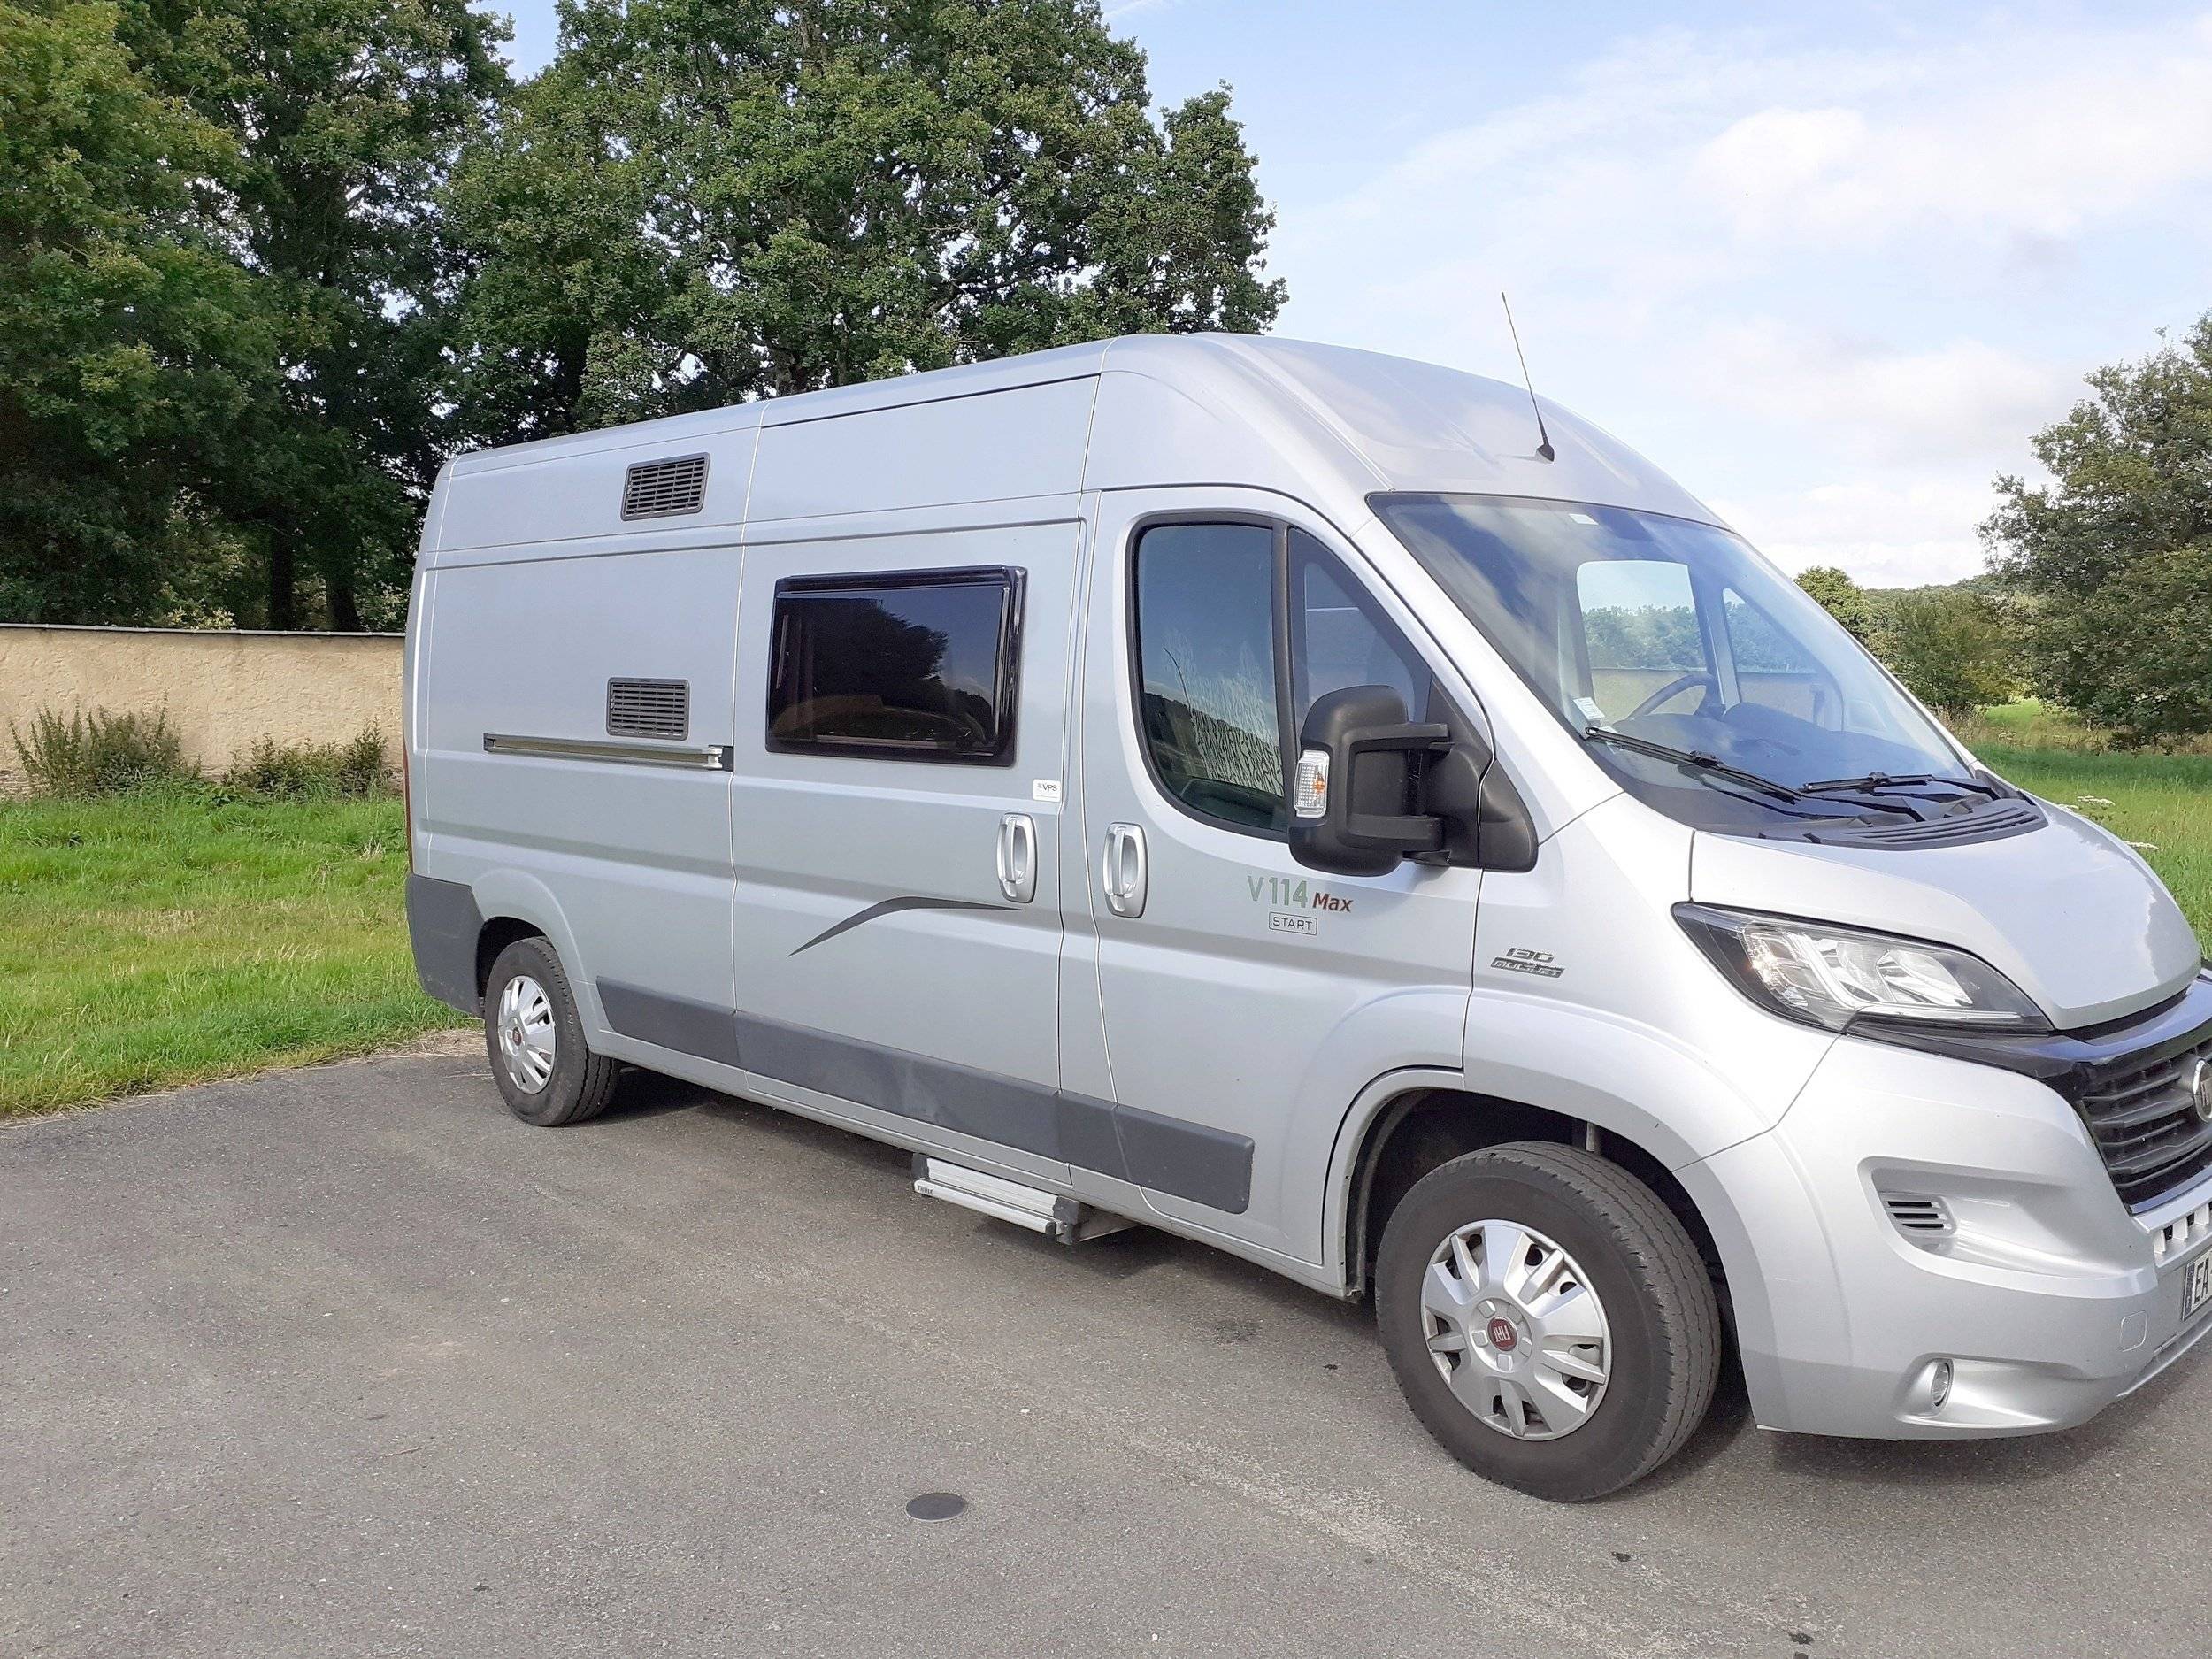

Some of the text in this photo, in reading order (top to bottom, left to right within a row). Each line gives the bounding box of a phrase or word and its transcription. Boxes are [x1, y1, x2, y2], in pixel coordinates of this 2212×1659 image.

[1312, 891, 1354, 912] Max
[1272, 916, 1313, 930] START
[1493, 1325, 1511, 1343] FIAT
